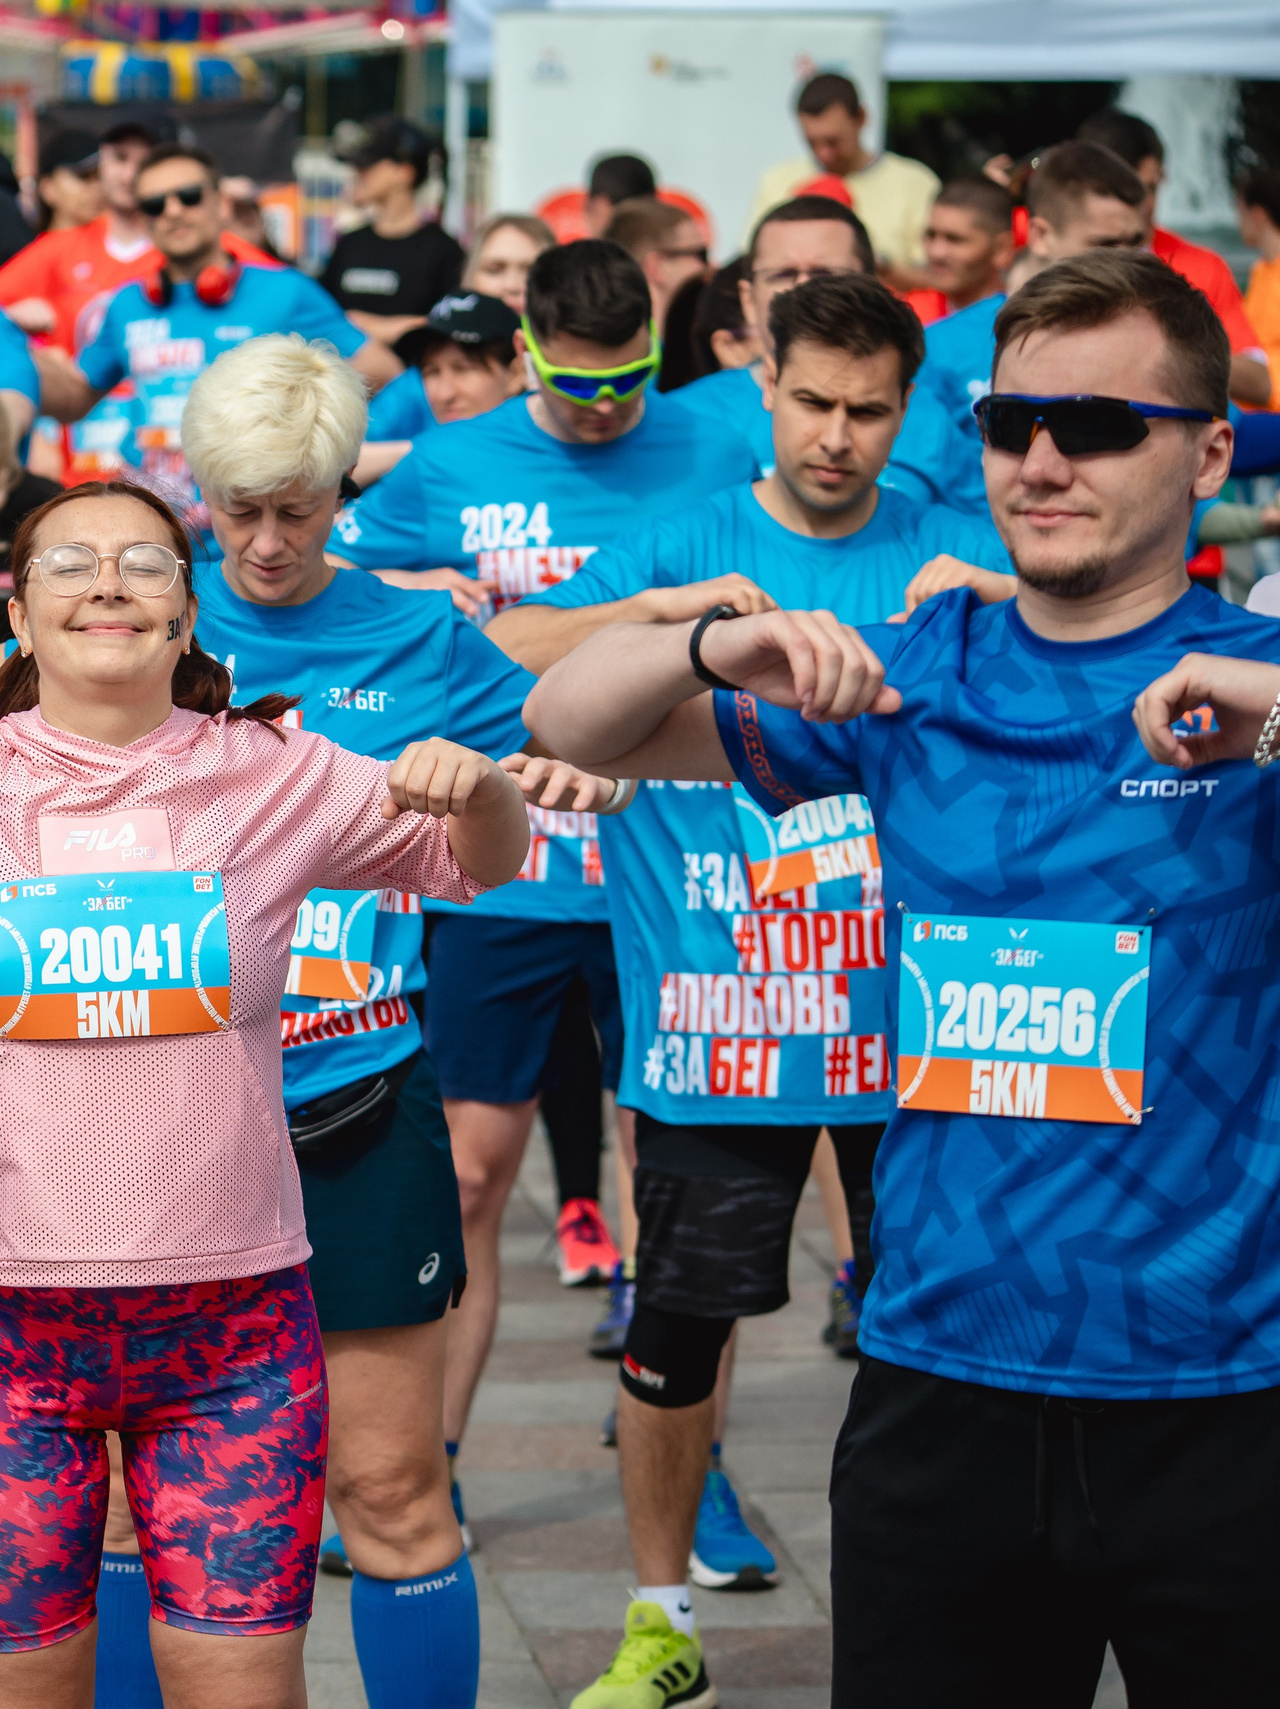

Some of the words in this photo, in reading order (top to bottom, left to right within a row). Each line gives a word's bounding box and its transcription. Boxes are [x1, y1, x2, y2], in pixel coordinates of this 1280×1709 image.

[460, 502, 553, 553] 2024
[476, 546, 599, 595] #МЕЧ
[1120, 779, 1219, 798] СПОРТ
[63, 822, 137, 852] FILA
[121, 847, 156, 861] PRO
[811, 836, 873, 883] 5KM
[23, 883, 57, 898] ПСБ
[195, 877, 212, 885] FON
[40, 923, 183, 984] 20041
[934, 924, 969, 941] ПСБ
[77, 989, 151, 1039] 5KM
[659, 972, 850, 1035] #ЛЮБОВЬ
[937, 980, 1097, 1057] 20256
[643, 1034, 780, 1097] #ЗАБЕГ
[969, 1059, 1048, 1118] 5KM
